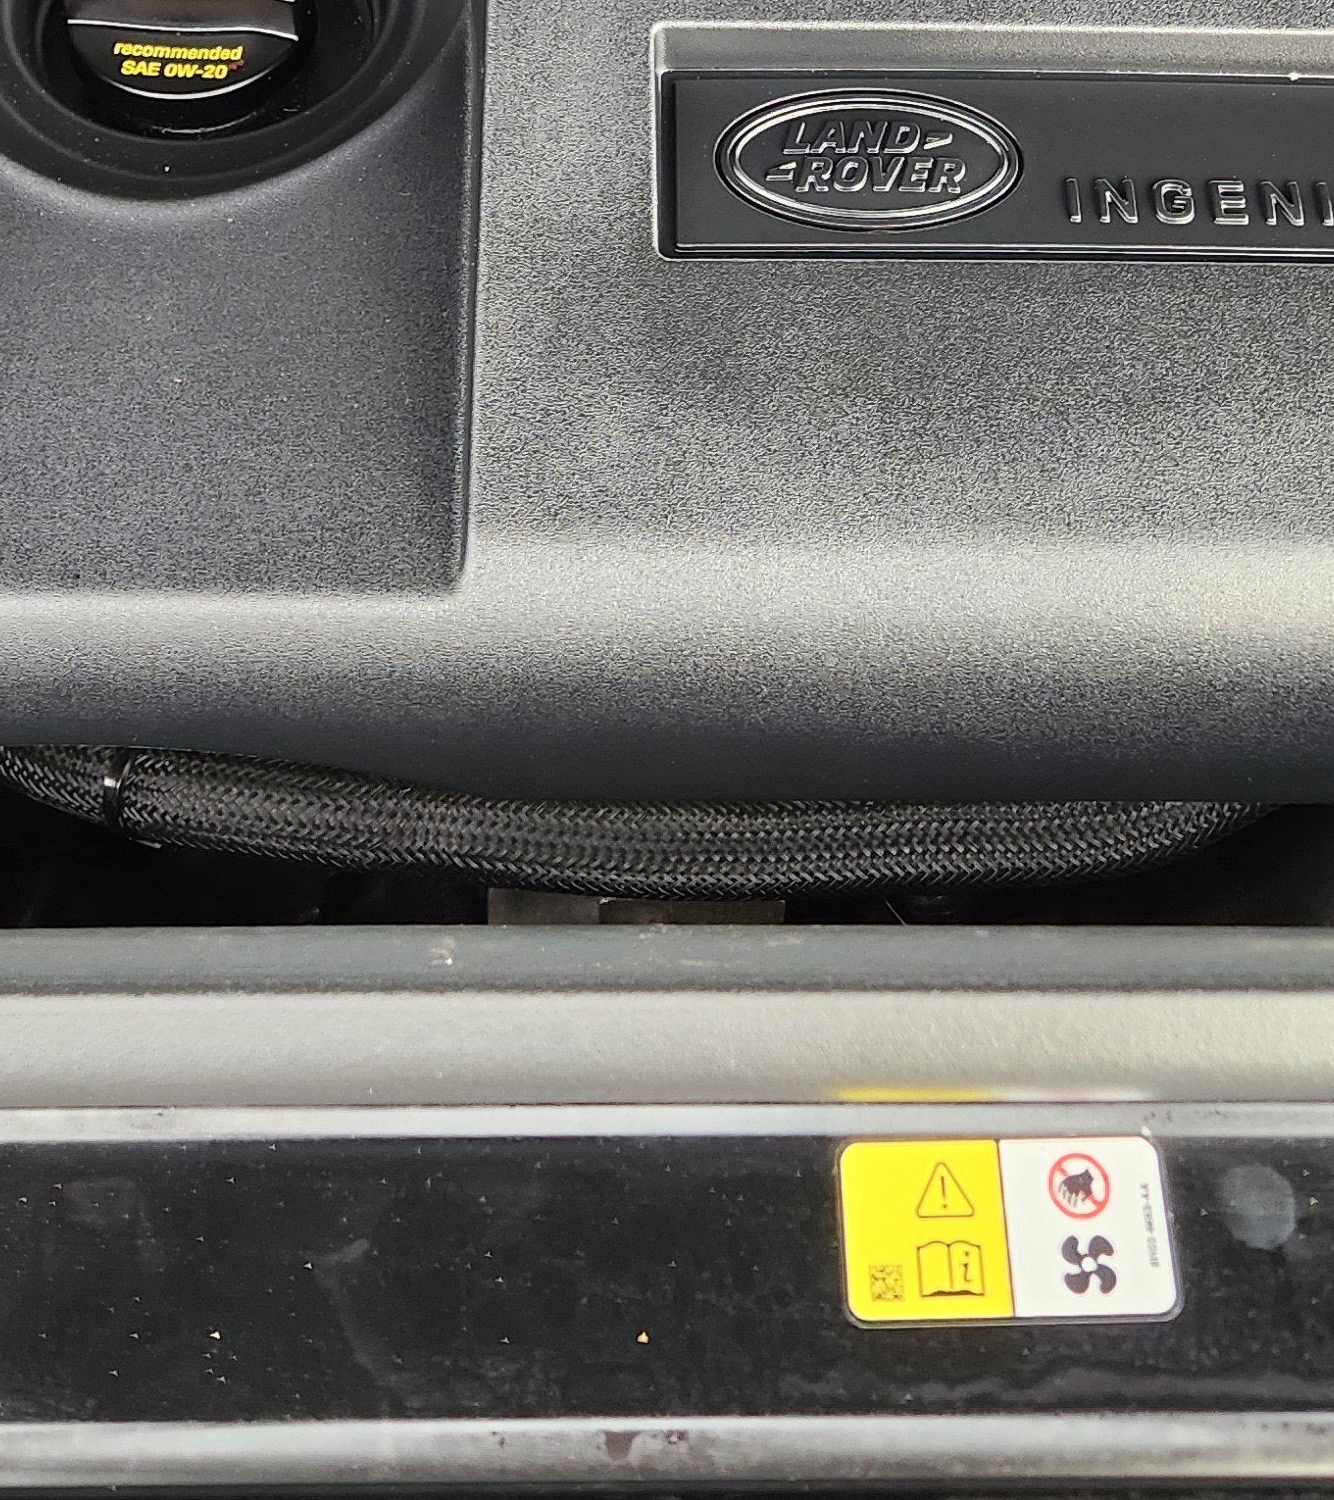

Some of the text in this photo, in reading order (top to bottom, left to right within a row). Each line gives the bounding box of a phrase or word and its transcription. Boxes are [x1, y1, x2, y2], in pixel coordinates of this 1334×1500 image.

[114, 42, 244, 61] recommended
[121, 59, 229, 80] SAE 0W-20
[782, 120, 922, 155] LAND
[795, 156, 967, 194] ROVER
